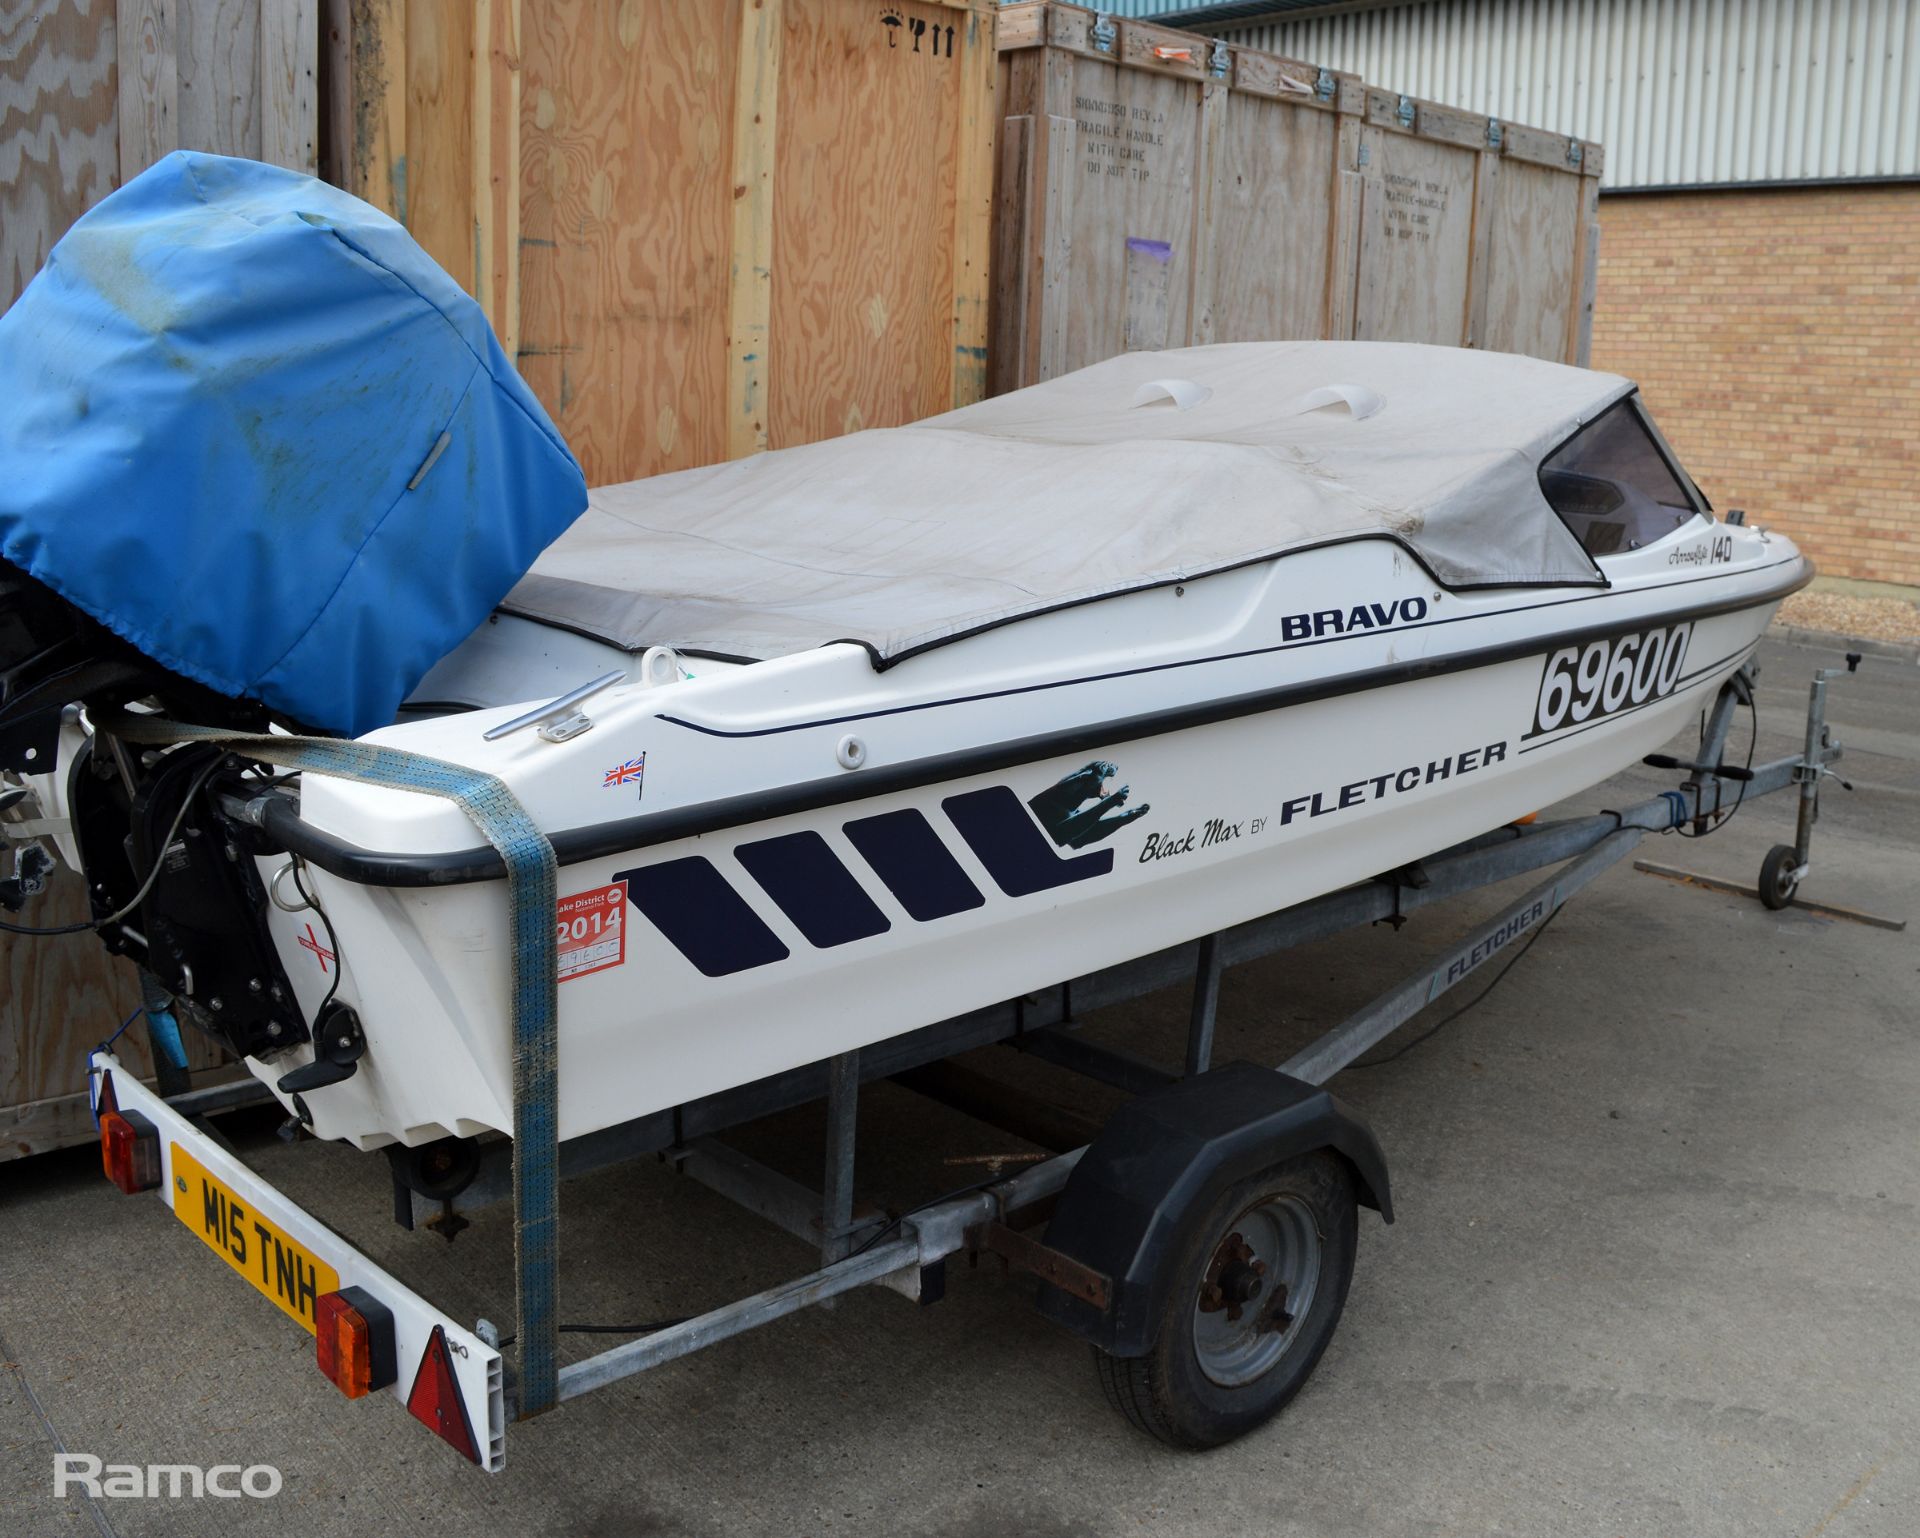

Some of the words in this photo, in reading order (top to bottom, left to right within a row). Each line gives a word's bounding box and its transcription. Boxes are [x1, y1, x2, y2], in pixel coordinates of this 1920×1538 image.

[1076, 119, 1120, 138] FRAGILE
[1126, 128, 1164, 147] HANDLE
[1087, 141, 1114, 158] WITH
[1119, 147, 1145, 162] CARE
[1087, 161, 1101, 174] DO
[1106, 165, 1125, 177] NOT
[1131, 168, 1150, 181] TIP
[1710, 536, 1732, 564] 140
[1281, 596, 1427, 642] BRAVO
[1538, 622, 1691, 731] 69600
[1138, 829, 1196, 864] Black
[1200, 818, 1245, 848] Max
[1250, 816, 1268, 835] BY
[1279, 741, 1507, 826] FLETCHER
[558, 903, 574, 913] ake
[575, 894, 605, 908] District
[557, 906, 622, 945] 2014
[1447, 901, 1543, 984] FLETCHER
[202, 1178, 247, 1265] M15
[254, 1220, 317, 1325] TNH
